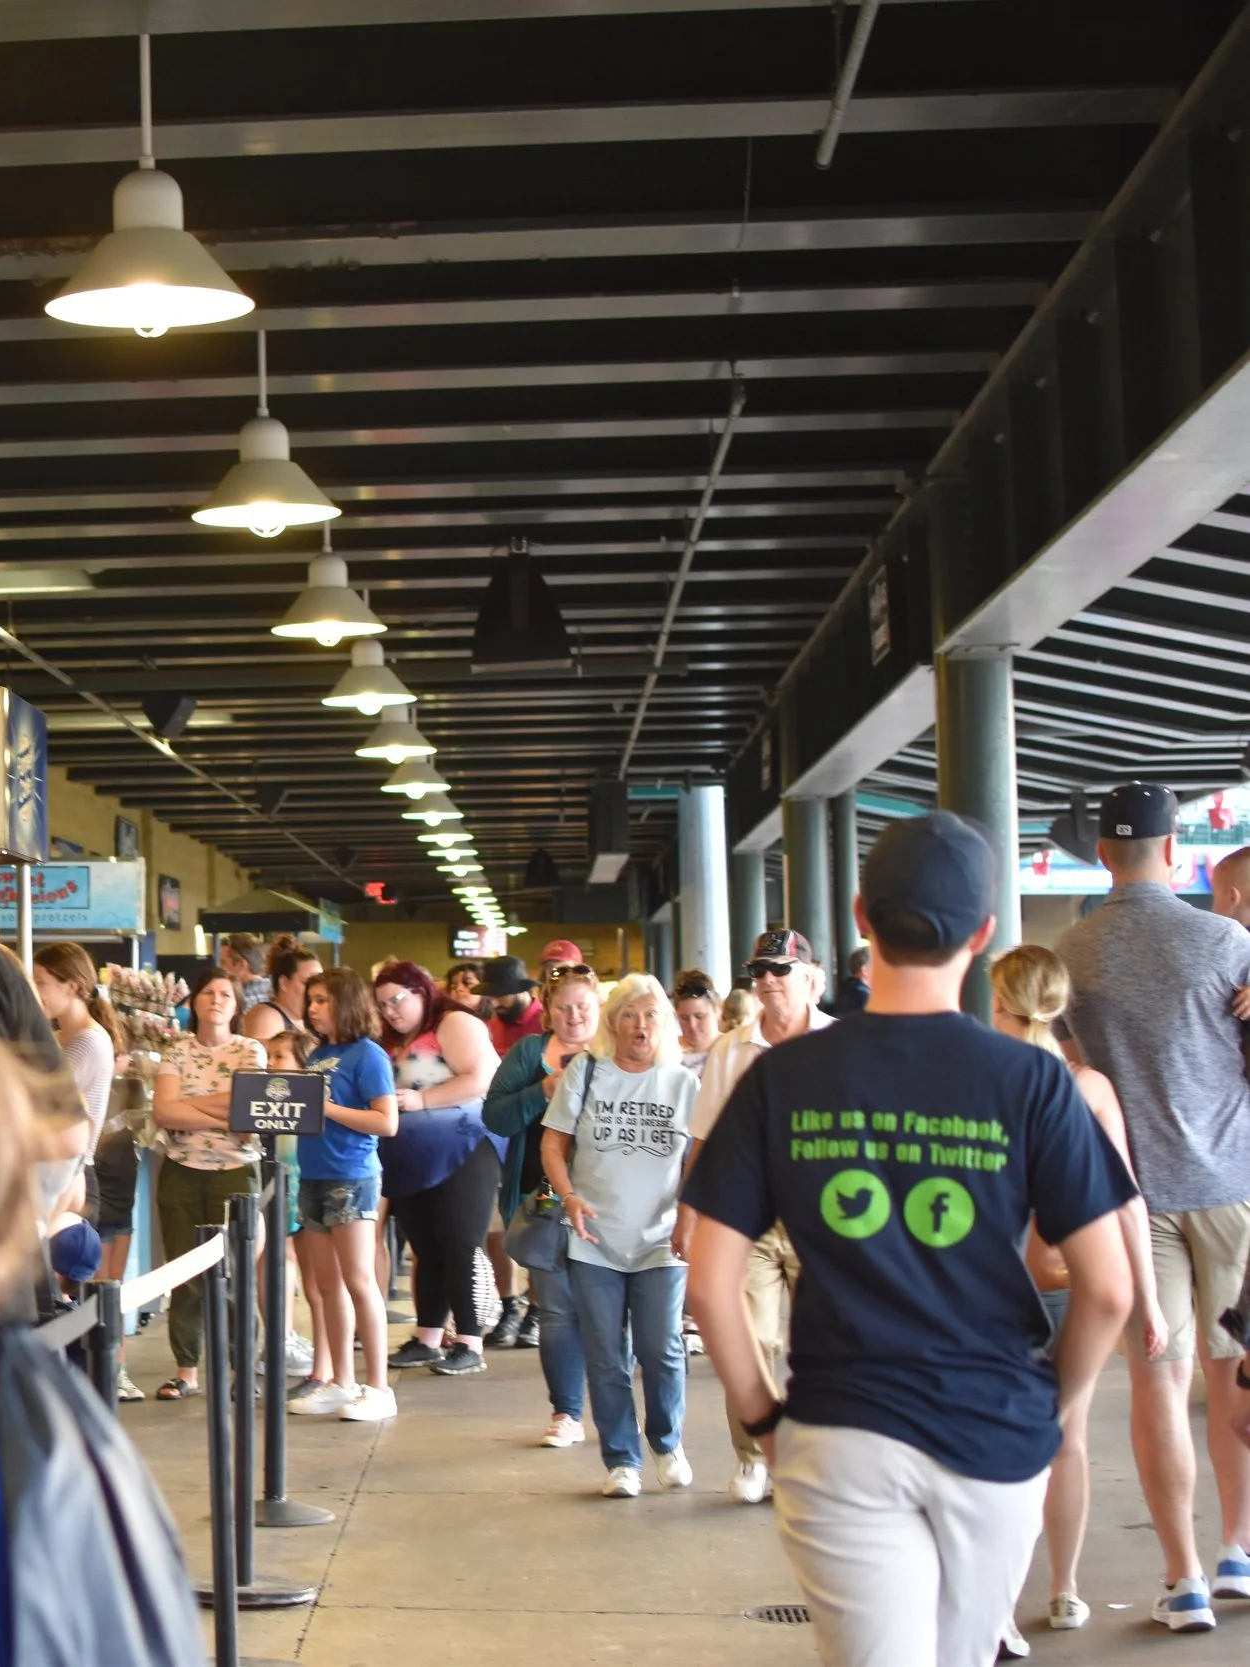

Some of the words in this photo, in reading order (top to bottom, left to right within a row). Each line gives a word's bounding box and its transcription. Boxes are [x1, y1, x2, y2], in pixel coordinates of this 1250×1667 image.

[249, 1101, 306, 1118] EXIT
[595, 1100, 614, 1114] I'M
[620, 1101, 675, 1119] RETIRED
[254, 1119, 299, 1130] ONLY
[594, 1116, 612, 1125] THIS
[615, 1116, 623, 1125] IS
[791, 1109, 833, 1133] Like
[839, 1110, 866, 1130] us
[871, 1111, 898, 1132] on
[593, 1126, 612, 1141] UP
[617, 1128, 636, 1142] AS
[650, 1129, 675, 1145] GET
[790, 1137, 859, 1161] Follow
[864, 1140, 889, 1160] us
[895, 1143, 922, 1164] on
[929, 1142, 1008, 1172] Twitter
